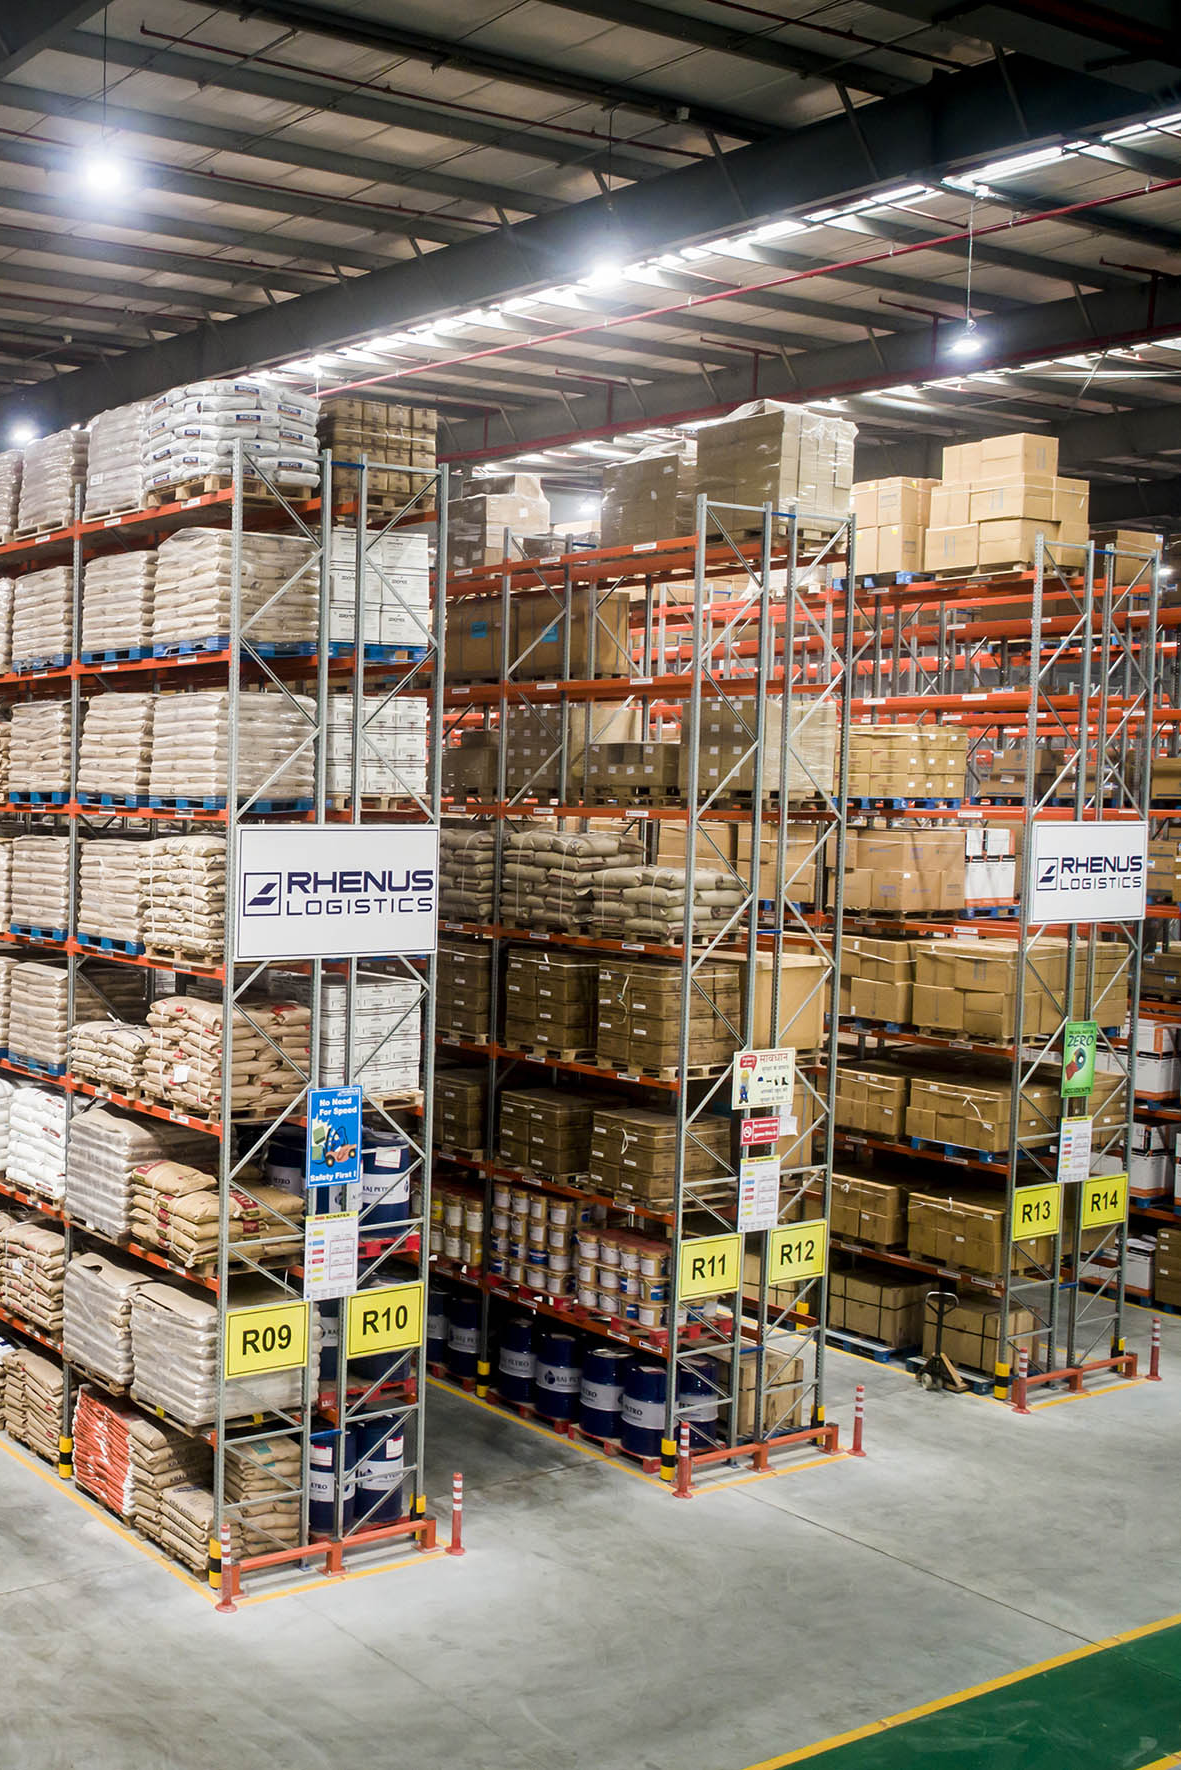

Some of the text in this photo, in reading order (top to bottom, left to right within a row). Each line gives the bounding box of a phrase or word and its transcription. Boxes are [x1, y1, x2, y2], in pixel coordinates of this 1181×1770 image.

[1060, 855, 1143, 874] RHENUS
[286, 869, 434, 894] RHENUS
[1059, 876, 1142, 891] LOGISTICS
[286, 897, 433, 915] LOGISTICS
[1067, 1034, 1094, 1047] ZERO
[319, 1097, 352, 1107] No Need
[319, 1106, 357, 1116] For Speed
[310, 1173, 334, 1182] Safety
[334, 1170, 352, 1179] First
[1022, 1200, 1051, 1224] R13
[1091, 1190, 1118, 1213] R14
[780, 1239, 815, 1266] R12
[692, 1253, 726, 1281] R11
[362, 1304, 408, 1336] R10
[242, 1323, 292, 1356] R09
